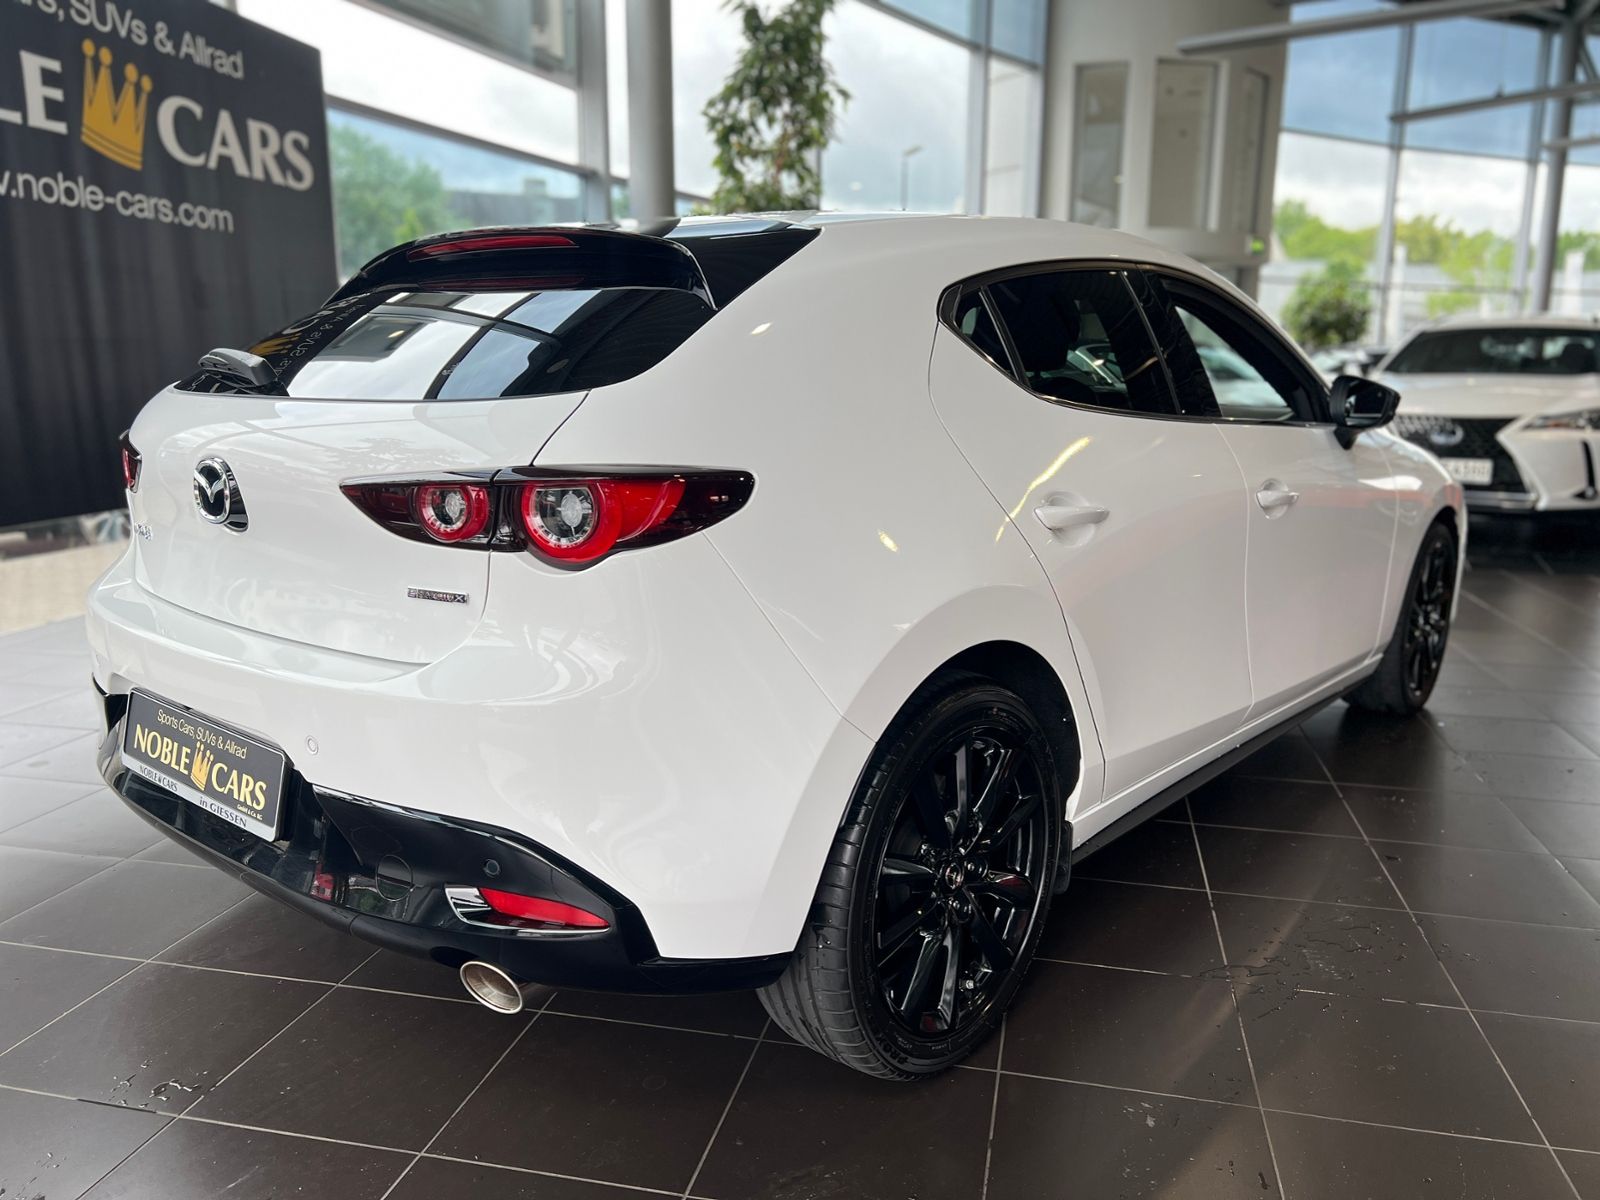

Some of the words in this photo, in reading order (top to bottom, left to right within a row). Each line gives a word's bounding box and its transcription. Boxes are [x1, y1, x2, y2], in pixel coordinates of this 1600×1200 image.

[69, 0, 148, 45] SUVs
[154, 22, 175, 54] &
[180, 31, 244, 79] Allrad
[157, 95, 314, 191] CARS
[134, 723, 191, 775] NOBLE
[211, 762, 267, 811] CARS
[157, 709, 178, 729] Sports
[178, 719, 195, 739] Cars,
[196, 727, 216, 746] SUVs
[217, 736, 224, 750] &
[224, 740, 248, 759] Allrad
[199, 796, 208, 808] in
[210, 803, 247, 828] GIESSEN
